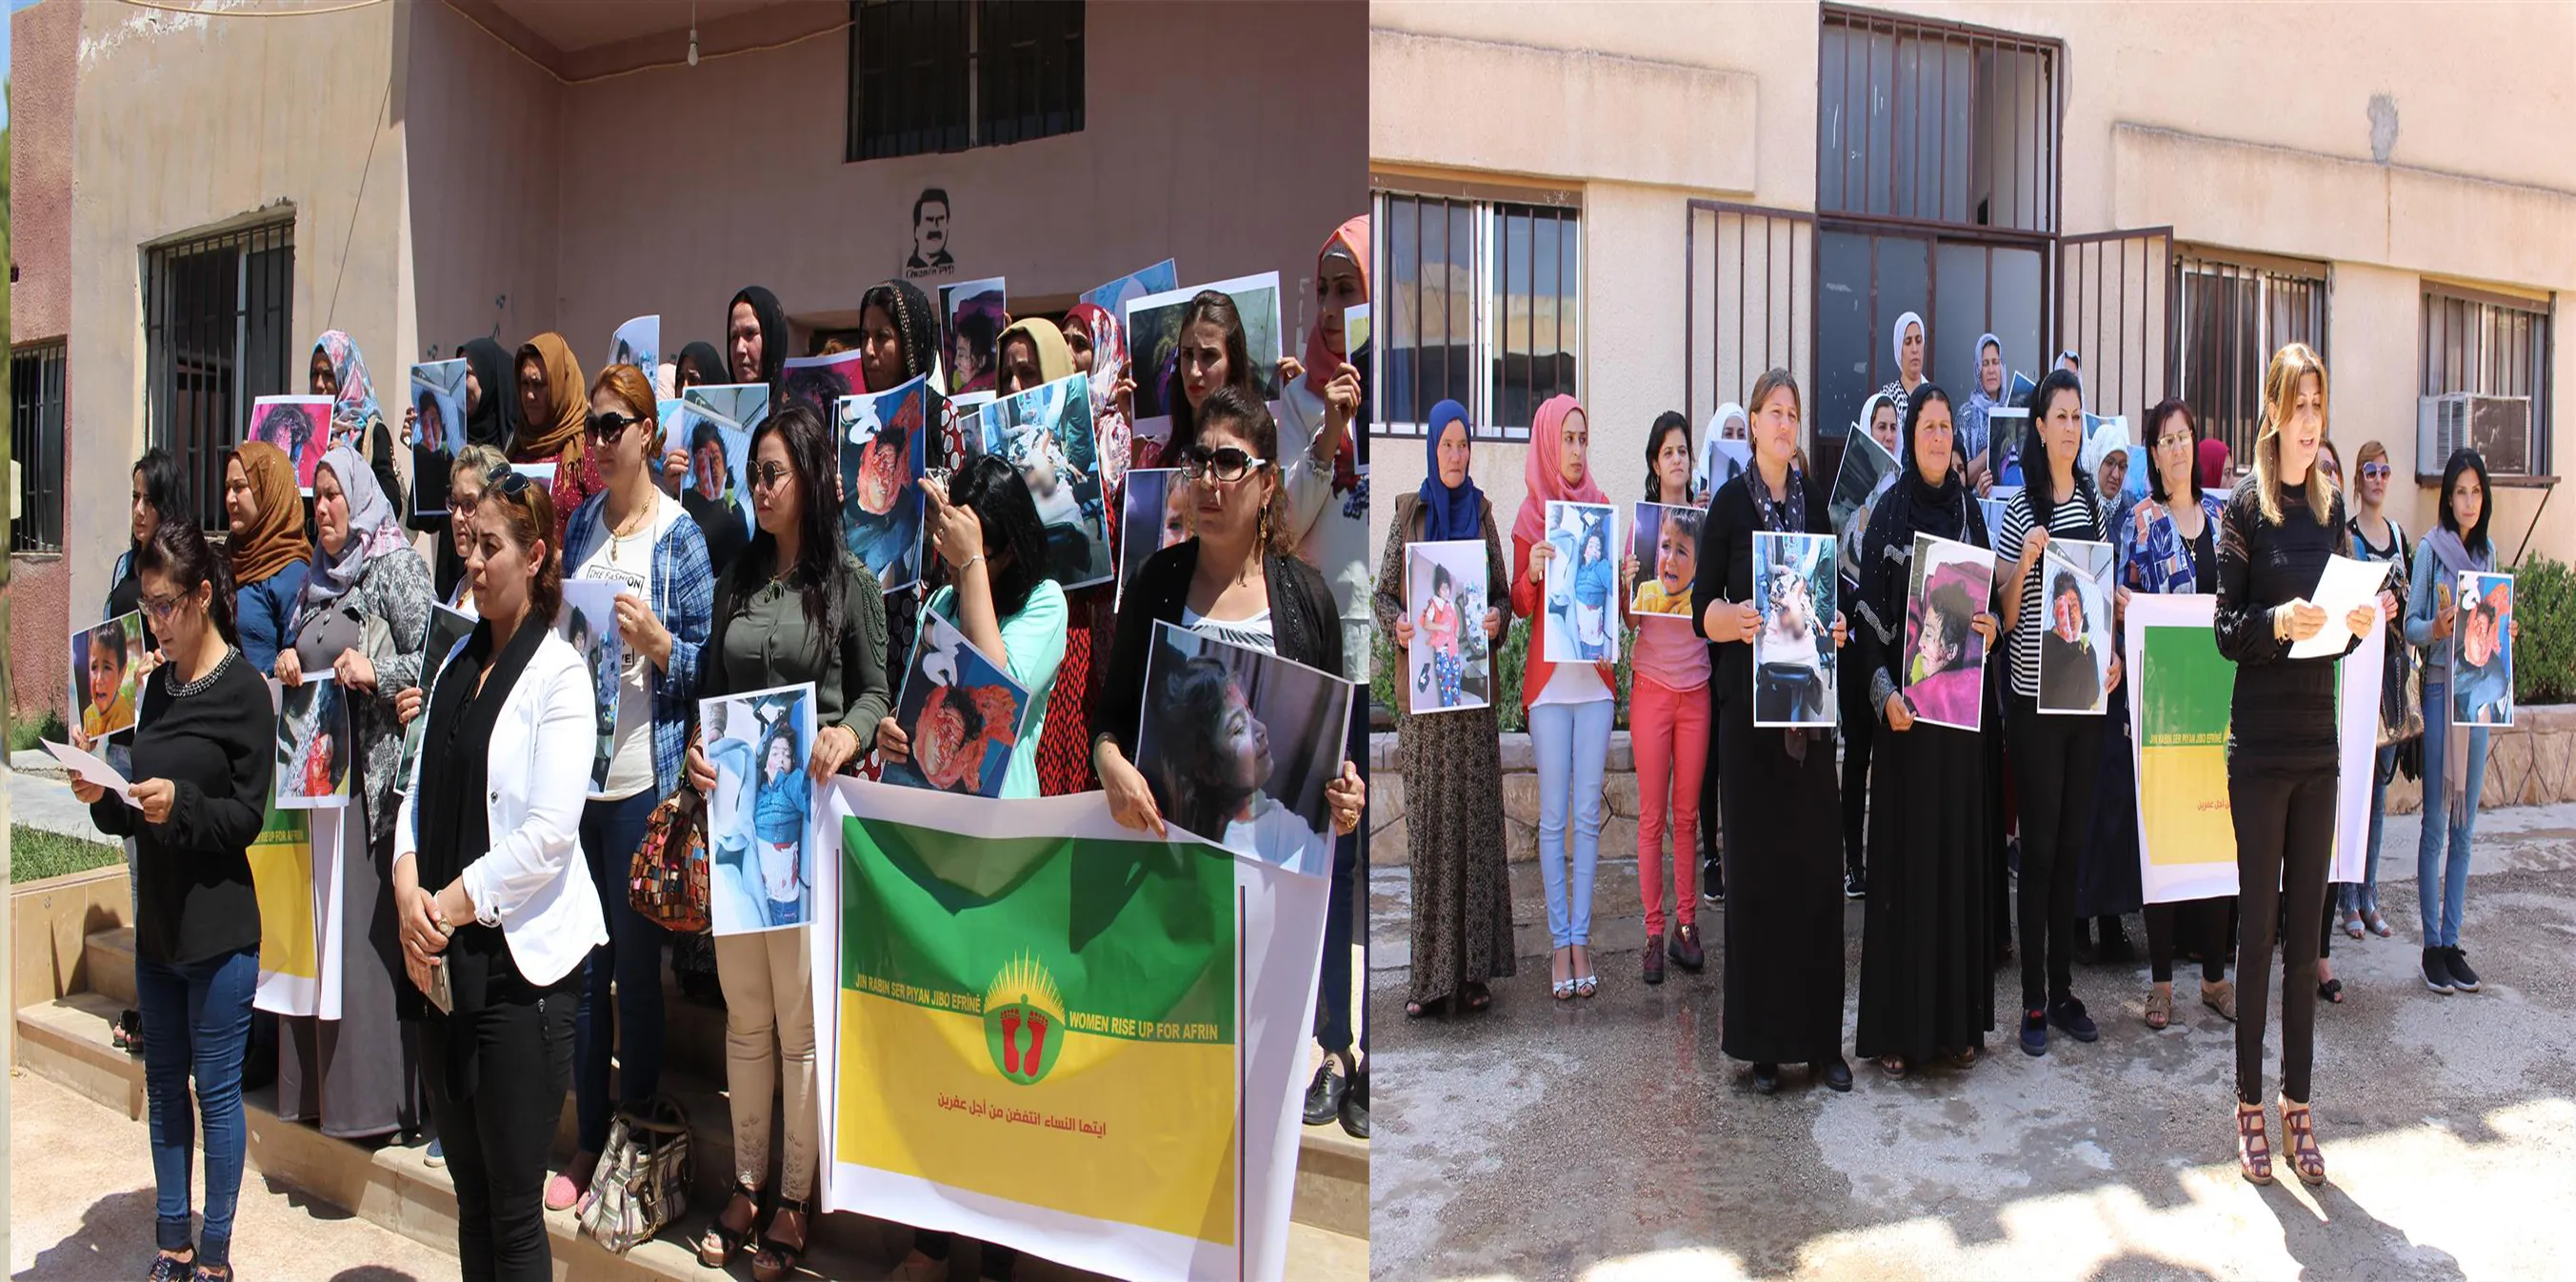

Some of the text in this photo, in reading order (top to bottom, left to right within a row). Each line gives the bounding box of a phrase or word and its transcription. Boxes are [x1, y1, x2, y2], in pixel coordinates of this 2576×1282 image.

[589, 569, 641, 590] THE FASHION
[856, 972, 868, 990] JIN
[869, 976, 890, 994] RABIN
[890, 982, 906, 997] SER
[906, 985, 930, 1004] PIYAN
[931, 991, 950, 1008] JIBO
[1069, 1012, 1218, 1040] WOMEN RISE UP FOR AFRIN
[937, 1092, 1107, 1138] ايتها النساء انتفضن من أجل عفرين
